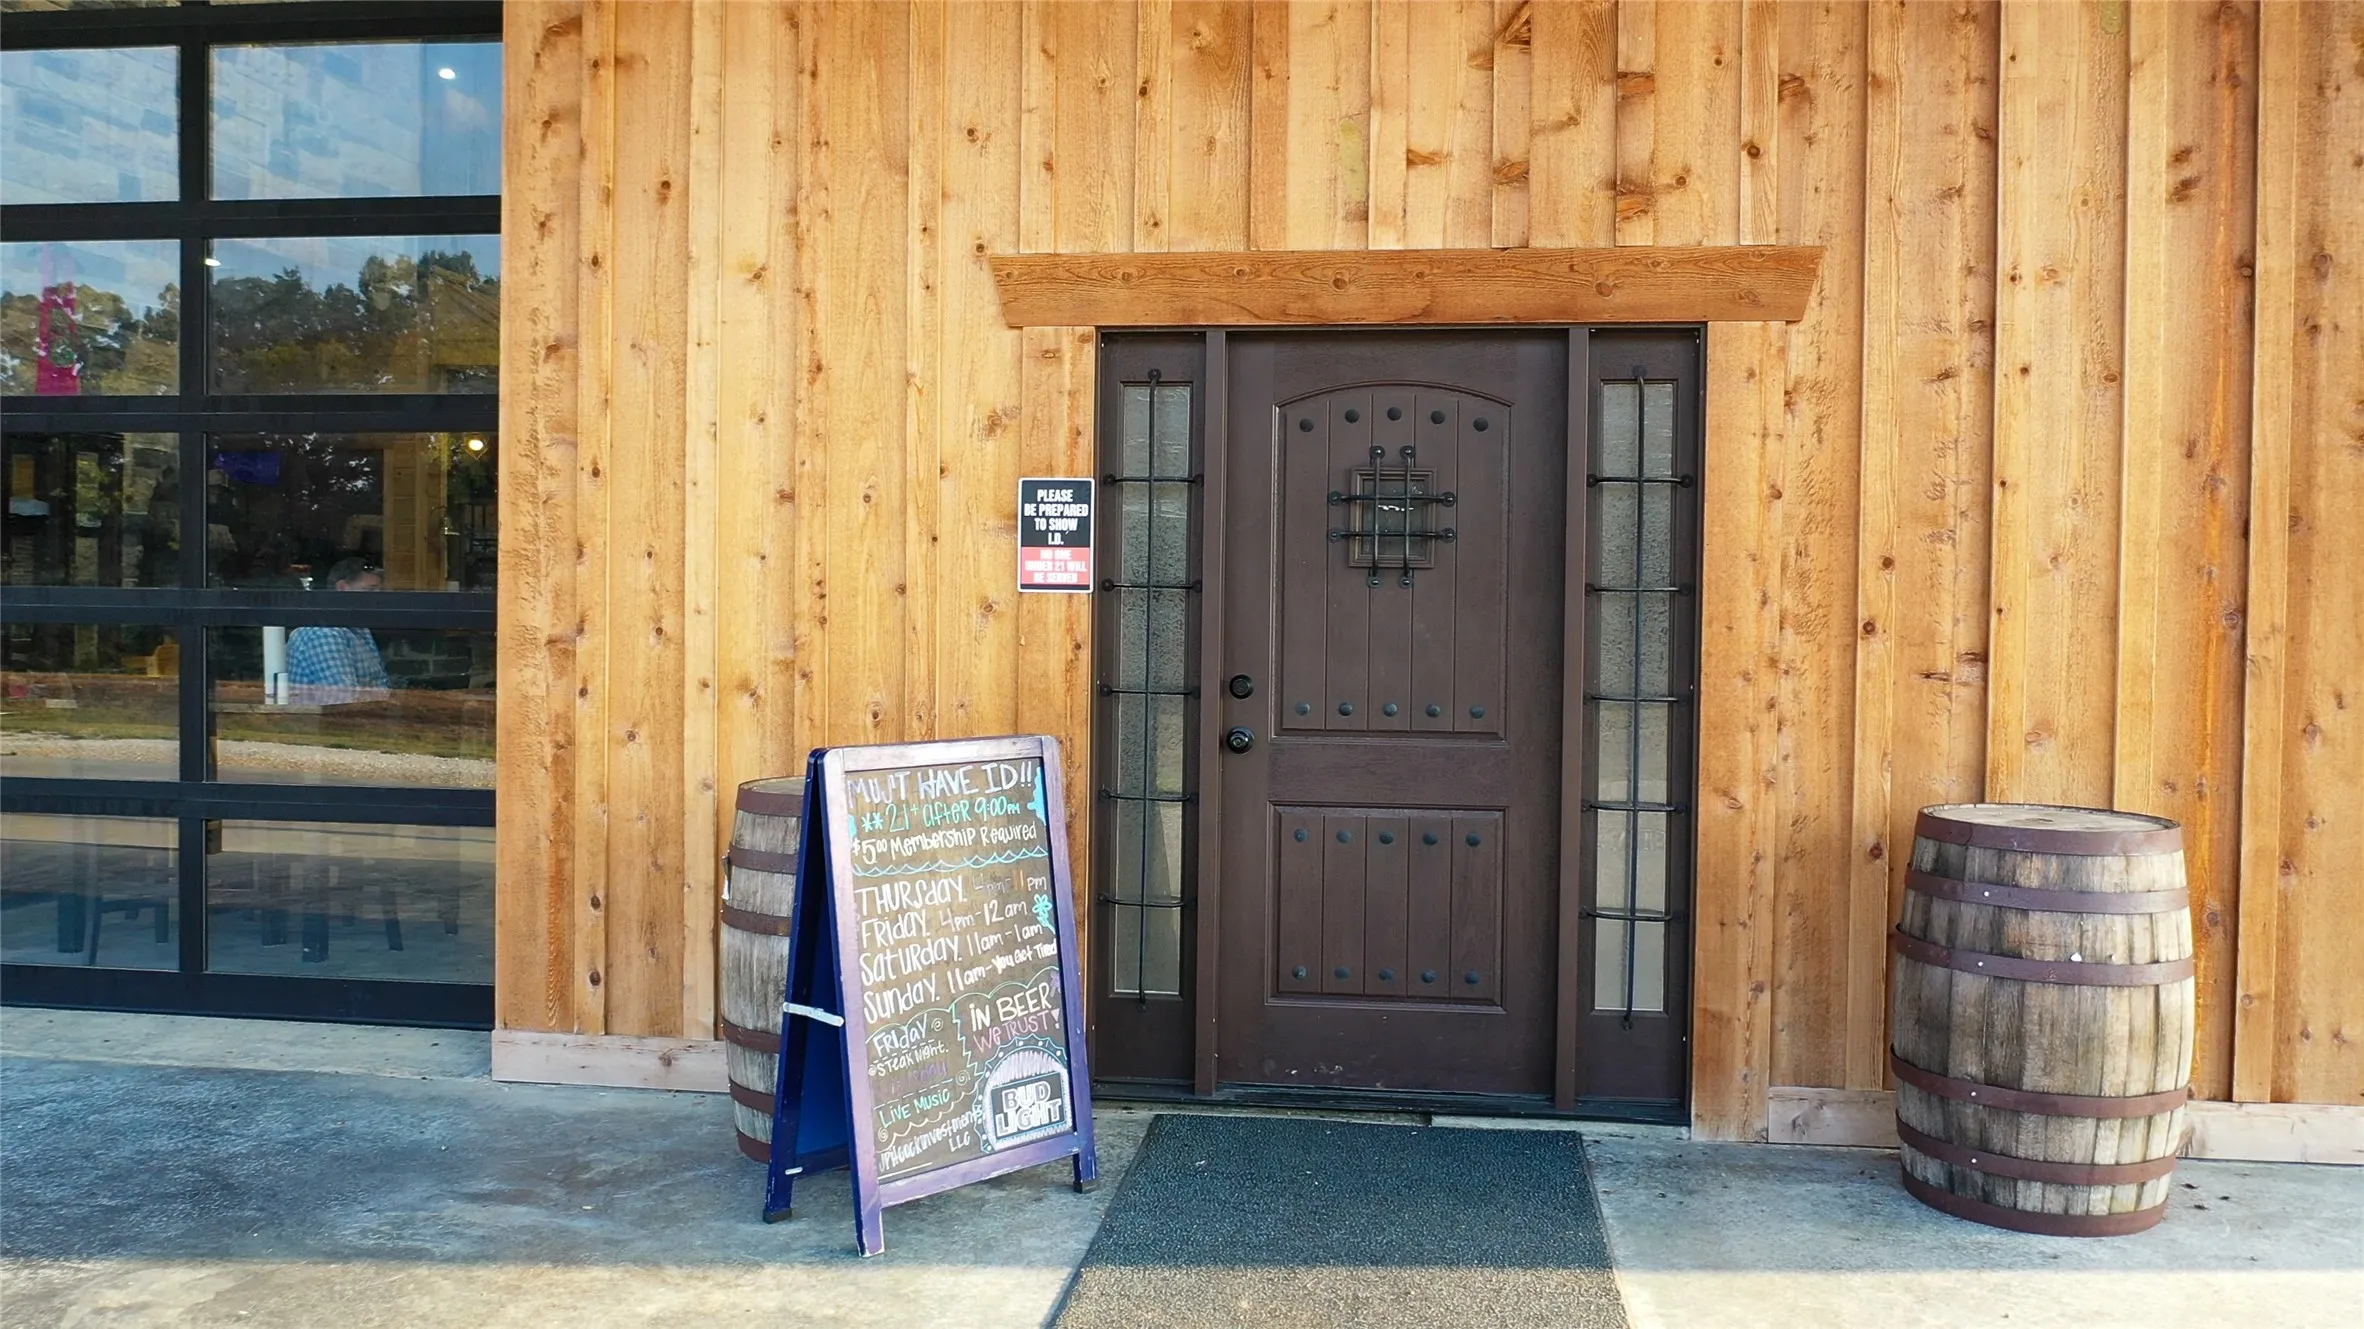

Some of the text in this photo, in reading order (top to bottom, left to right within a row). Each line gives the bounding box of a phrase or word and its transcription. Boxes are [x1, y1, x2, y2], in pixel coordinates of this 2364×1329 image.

[1037, 489, 1073, 502] PLEASE
[1024, 503, 1089, 517] BE PREPARED
[1034, 518, 1078, 531] TO SHOW
[1047, 532, 1064, 545] I.D.
[1054, 560, 1065, 571] 21
[1066, 560, 1088, 571] WILL
[847, 761, 1032, 809] MUST HAVE ID!!
[996, 982, 1052, 1022] BEER
[1002, 1081, 1051, 1112] BUD
[995, 1098, 1062, 1137] LIGHT
[948, 1131, 971, 1152] LLC
